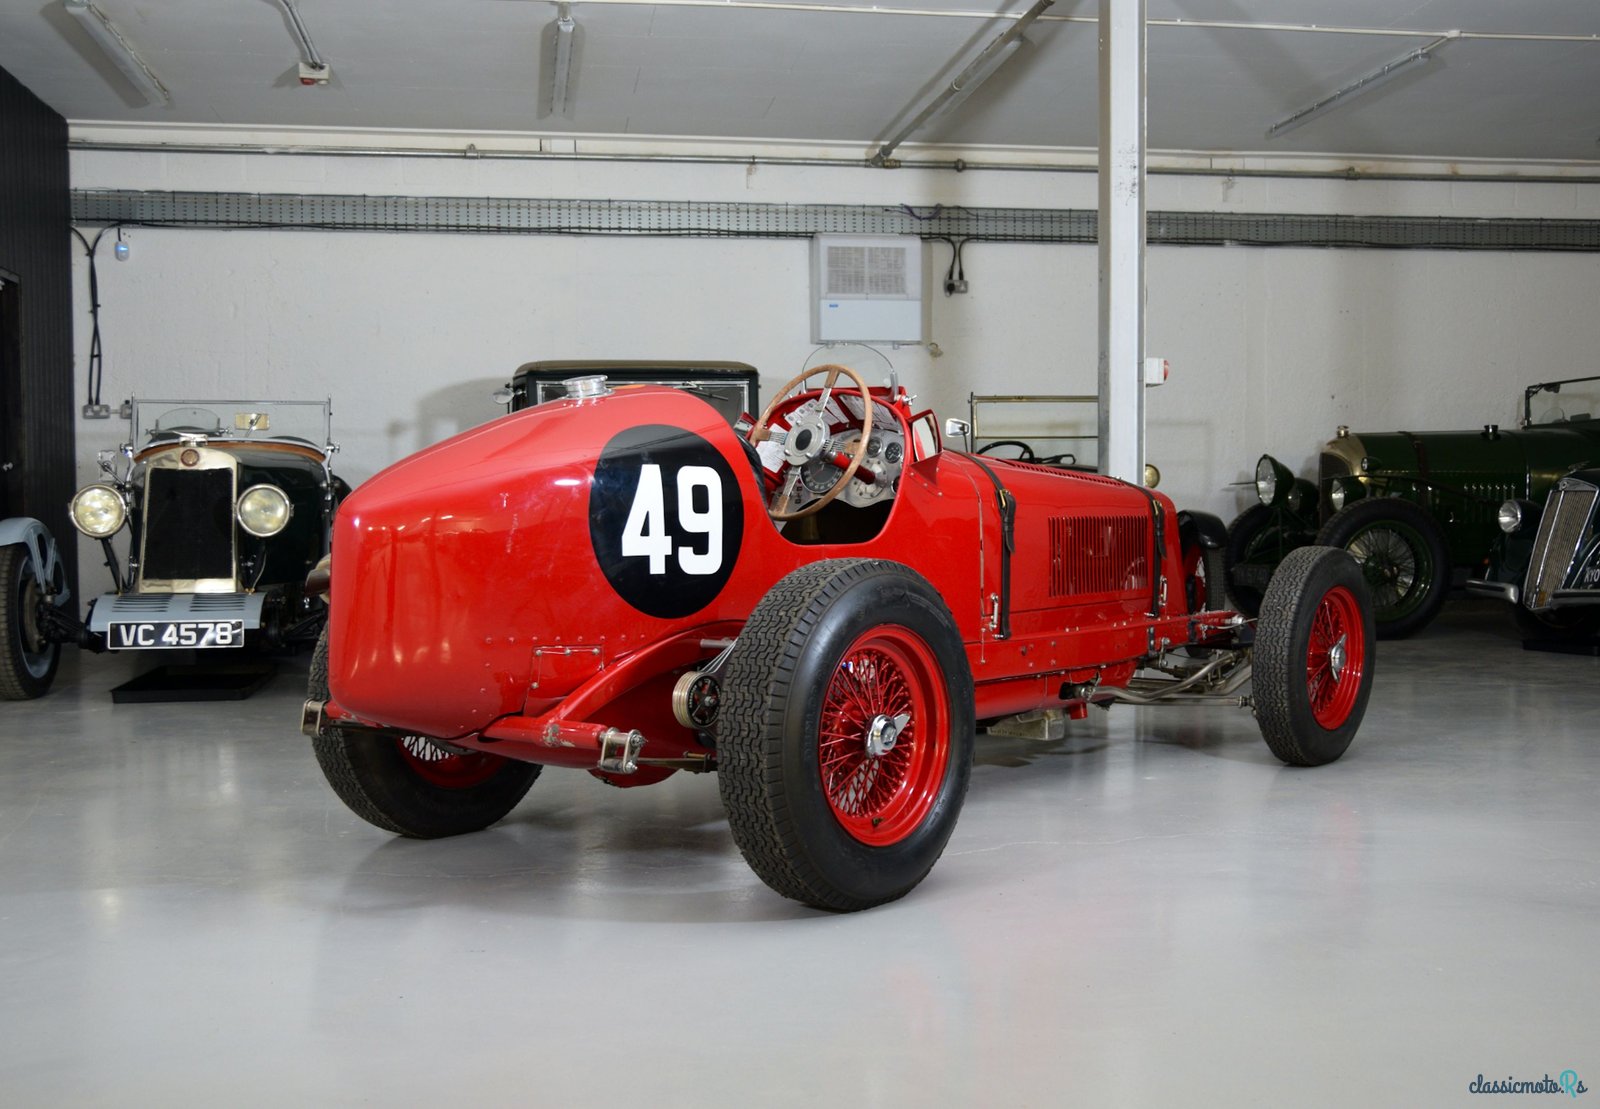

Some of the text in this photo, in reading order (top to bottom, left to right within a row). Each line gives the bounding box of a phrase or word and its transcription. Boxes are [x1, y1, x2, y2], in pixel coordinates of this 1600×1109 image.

[621, 464, 723, 575] 49
[120, 623, 233, 647] VC 4578
